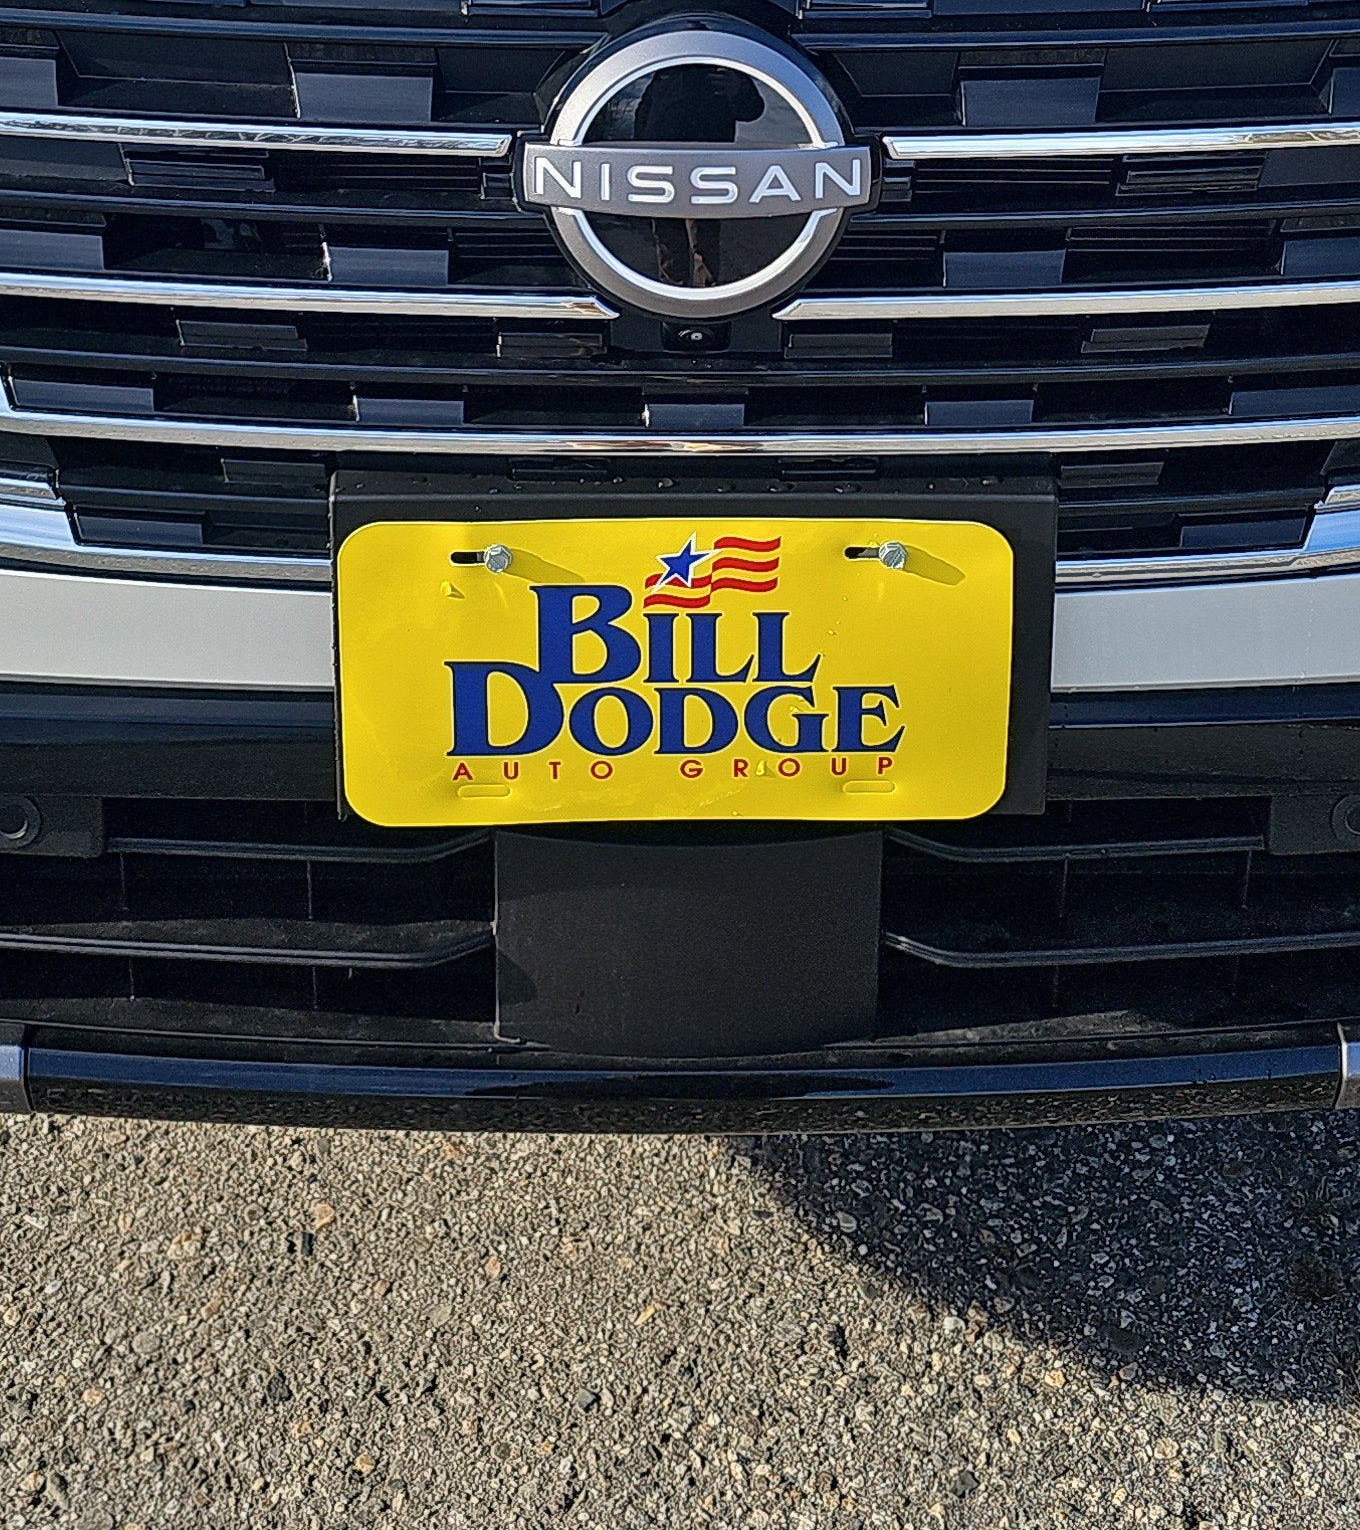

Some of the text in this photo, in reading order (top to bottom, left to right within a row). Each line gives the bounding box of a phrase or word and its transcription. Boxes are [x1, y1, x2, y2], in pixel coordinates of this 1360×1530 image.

[534, 157, 862, 204] NISSAN
[529, 584, 822, 684] BILL
[444, 660, 906, 756] DODGE
[452, 756, 894, 781] AUTO GROUP
